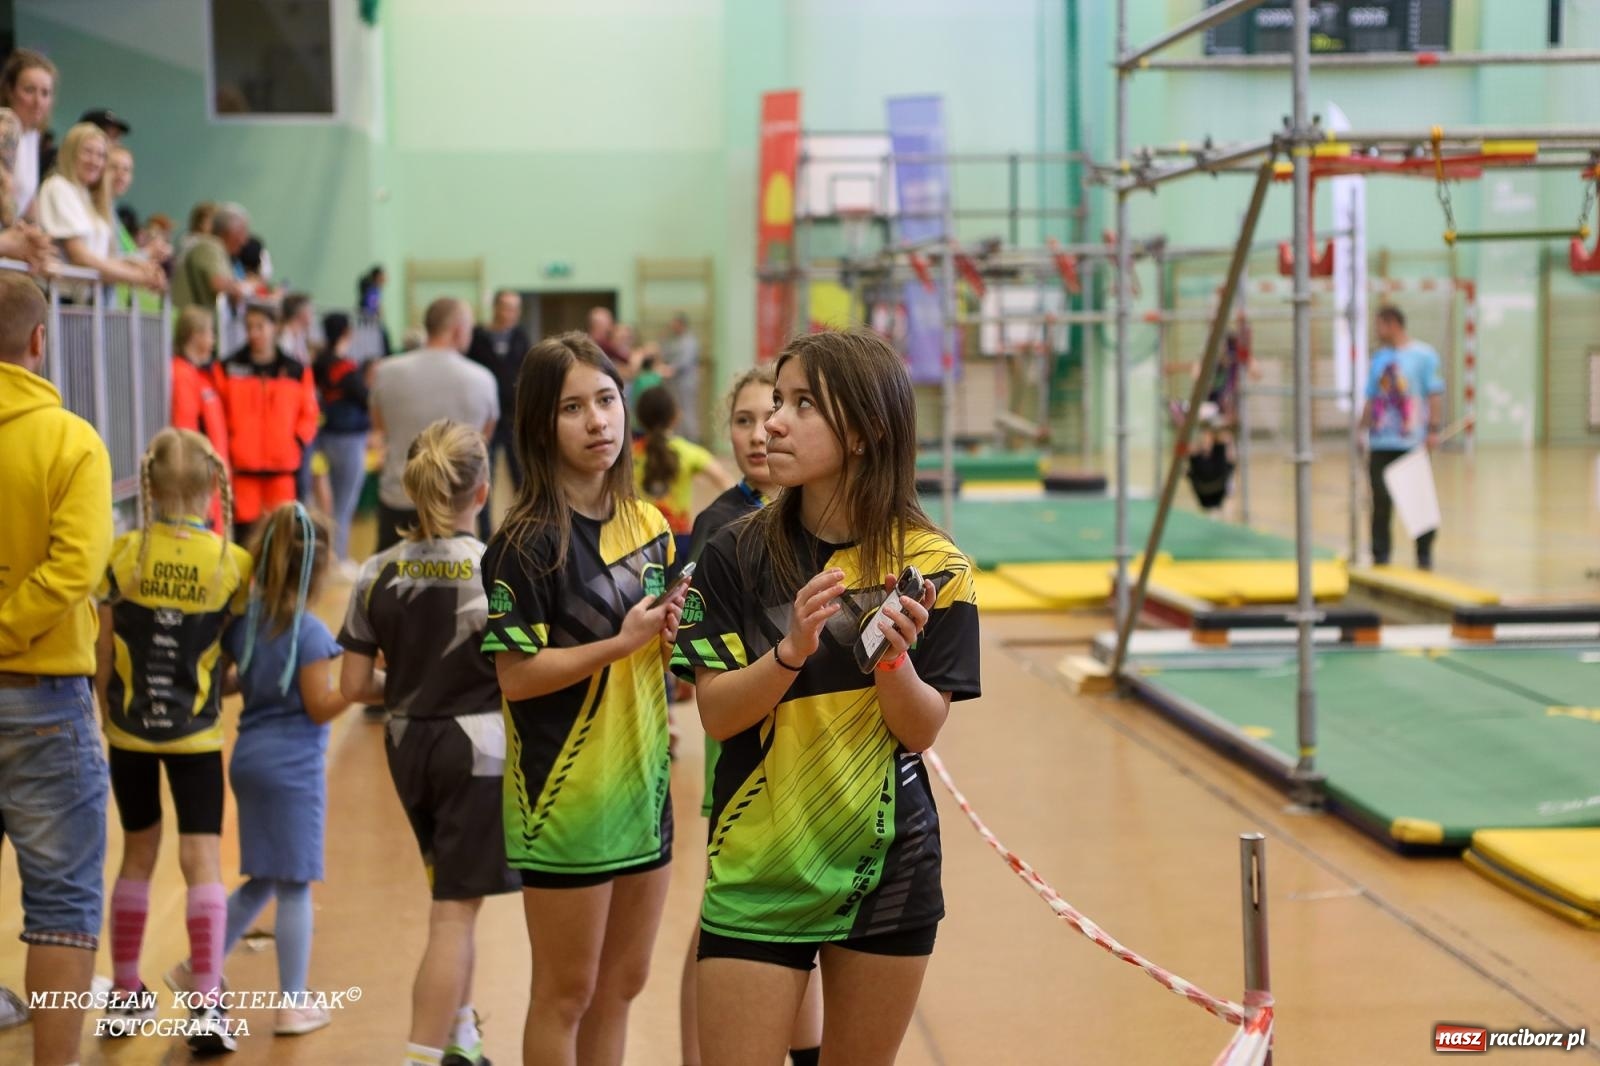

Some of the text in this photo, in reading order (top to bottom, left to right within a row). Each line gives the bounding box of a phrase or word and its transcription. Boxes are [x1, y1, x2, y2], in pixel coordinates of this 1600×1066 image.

[153, 562, 199, 582] GOSIA
[396, 558, 474, 580] TOMUŚ
[875, 810, 886, 835] the
